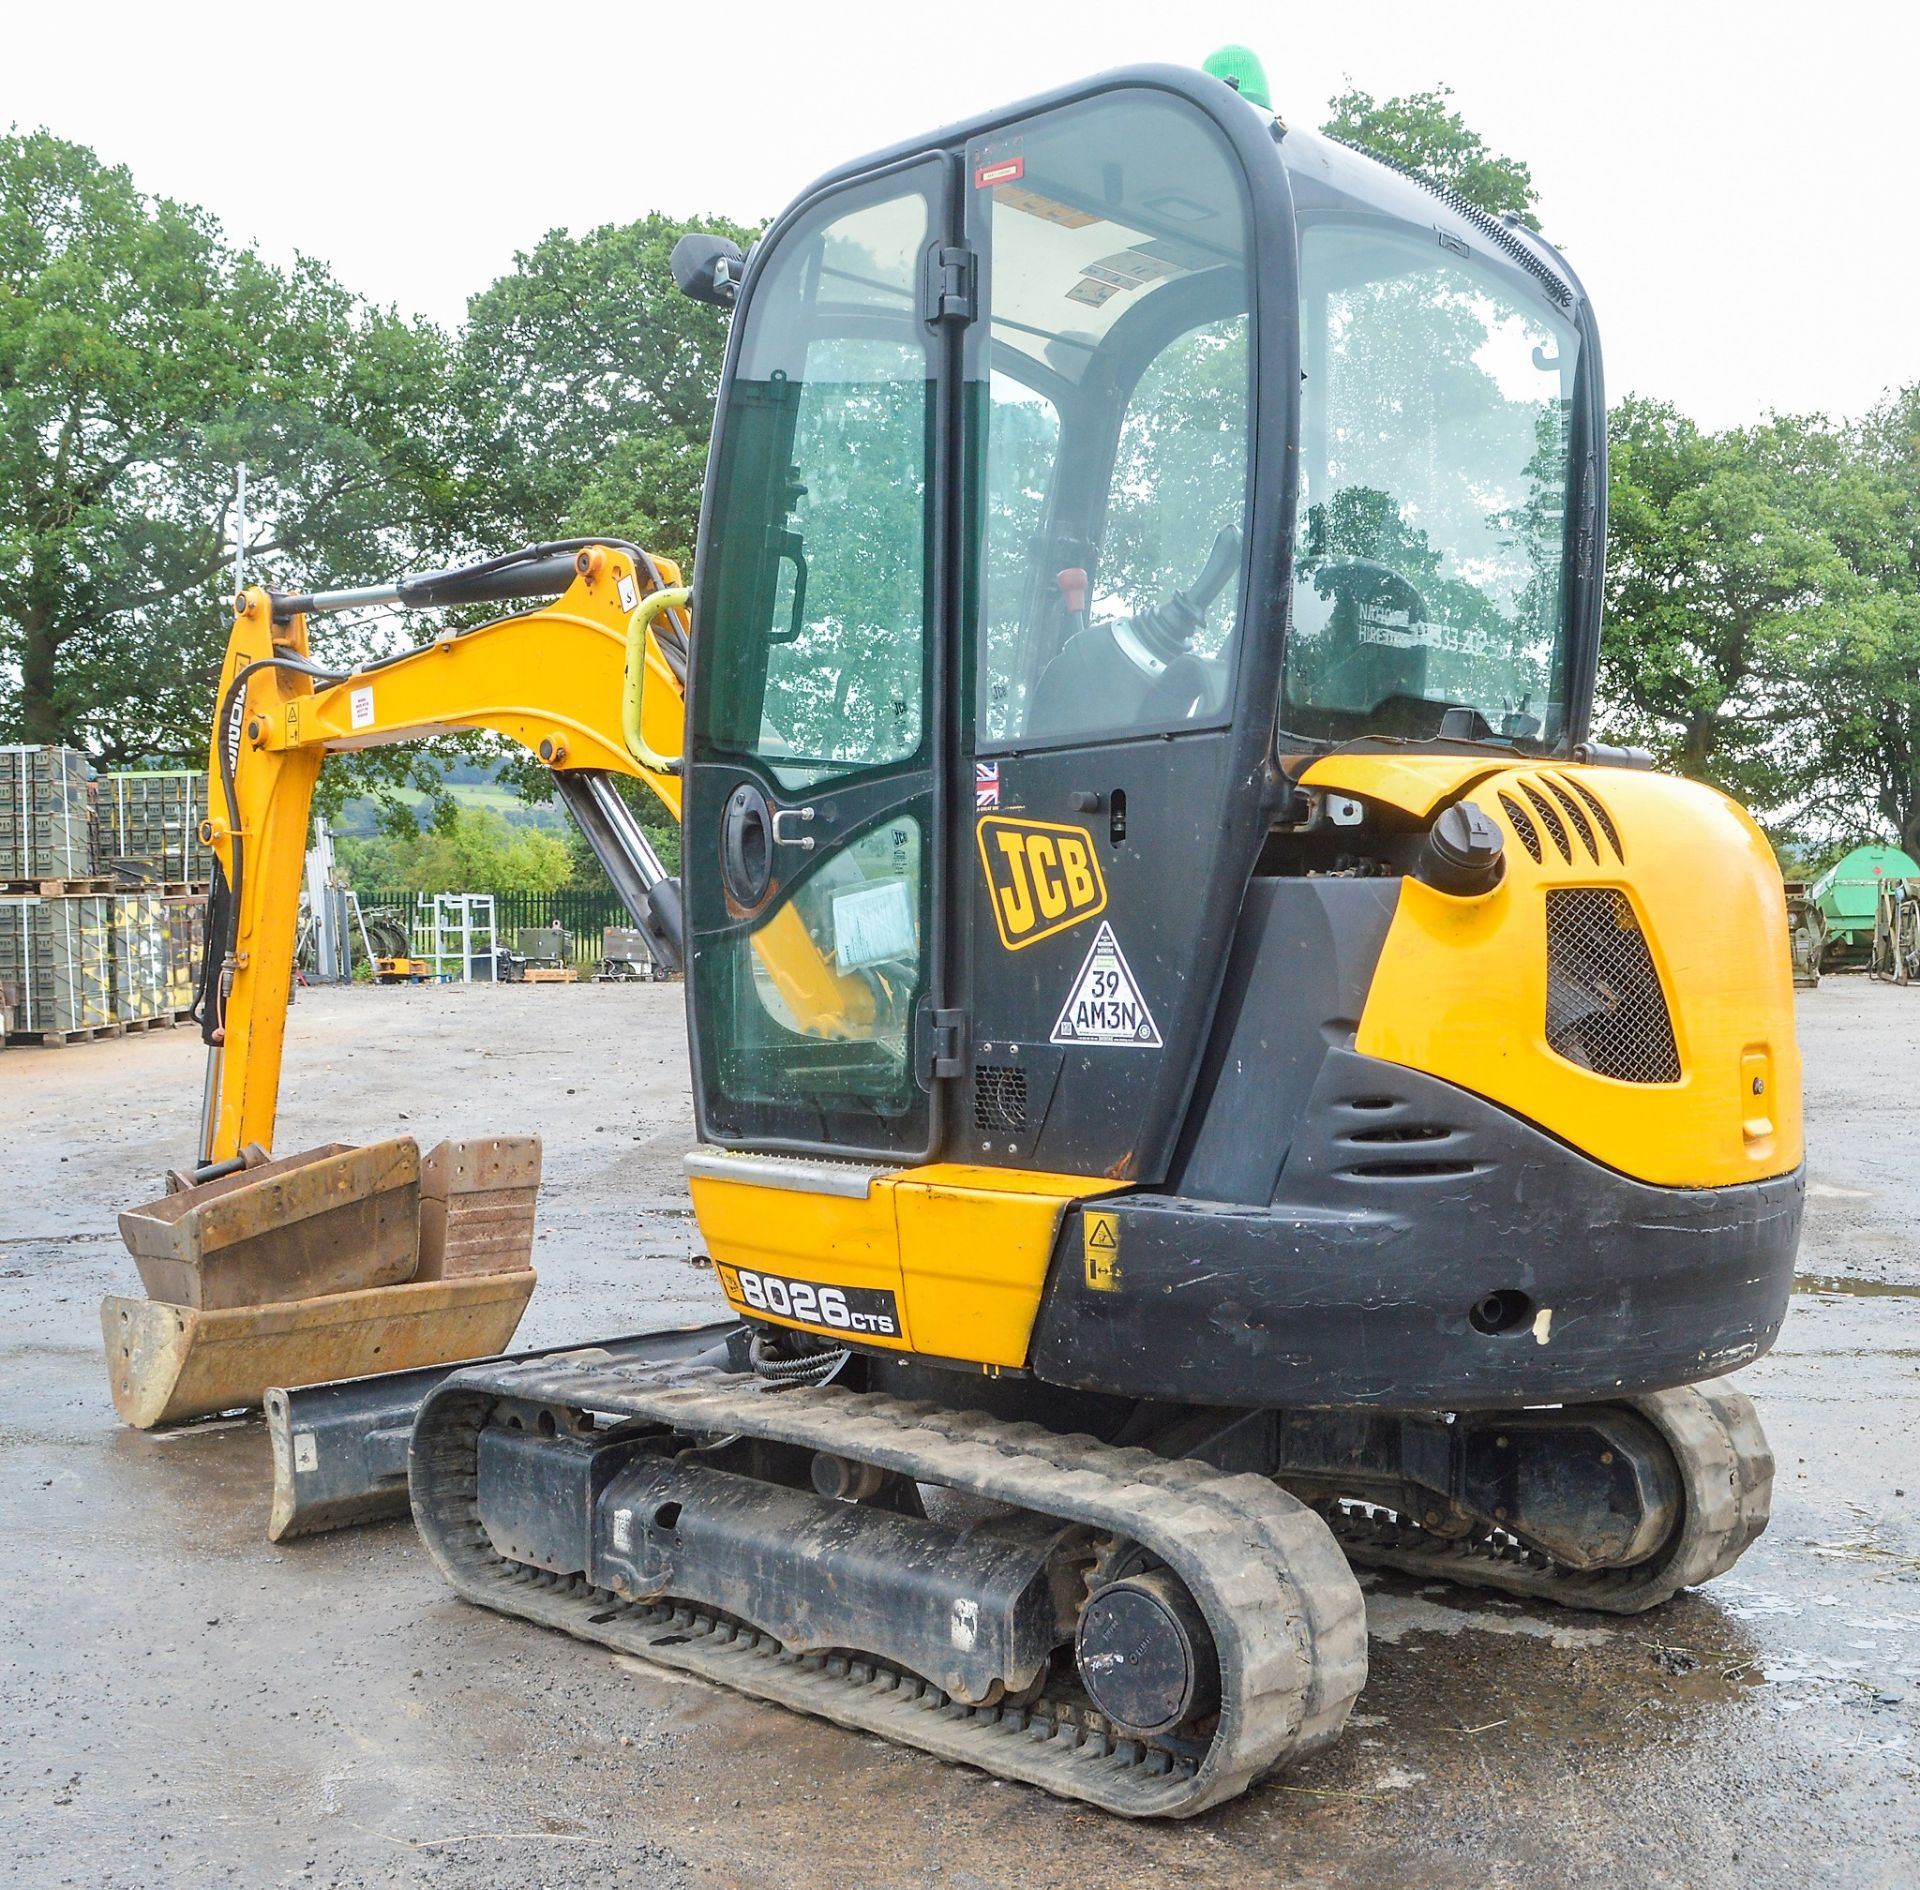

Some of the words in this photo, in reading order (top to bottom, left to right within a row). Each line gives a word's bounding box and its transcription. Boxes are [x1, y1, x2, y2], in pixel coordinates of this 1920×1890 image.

[996, 831, 1095, 934] JCB
[1091, 970, 1119, 998] 39
[1076, 1001, 1136, 1030] AM3N
[739, 1270, 850, 1328] 8026
[850, 1312, 895, 1333] CTS
